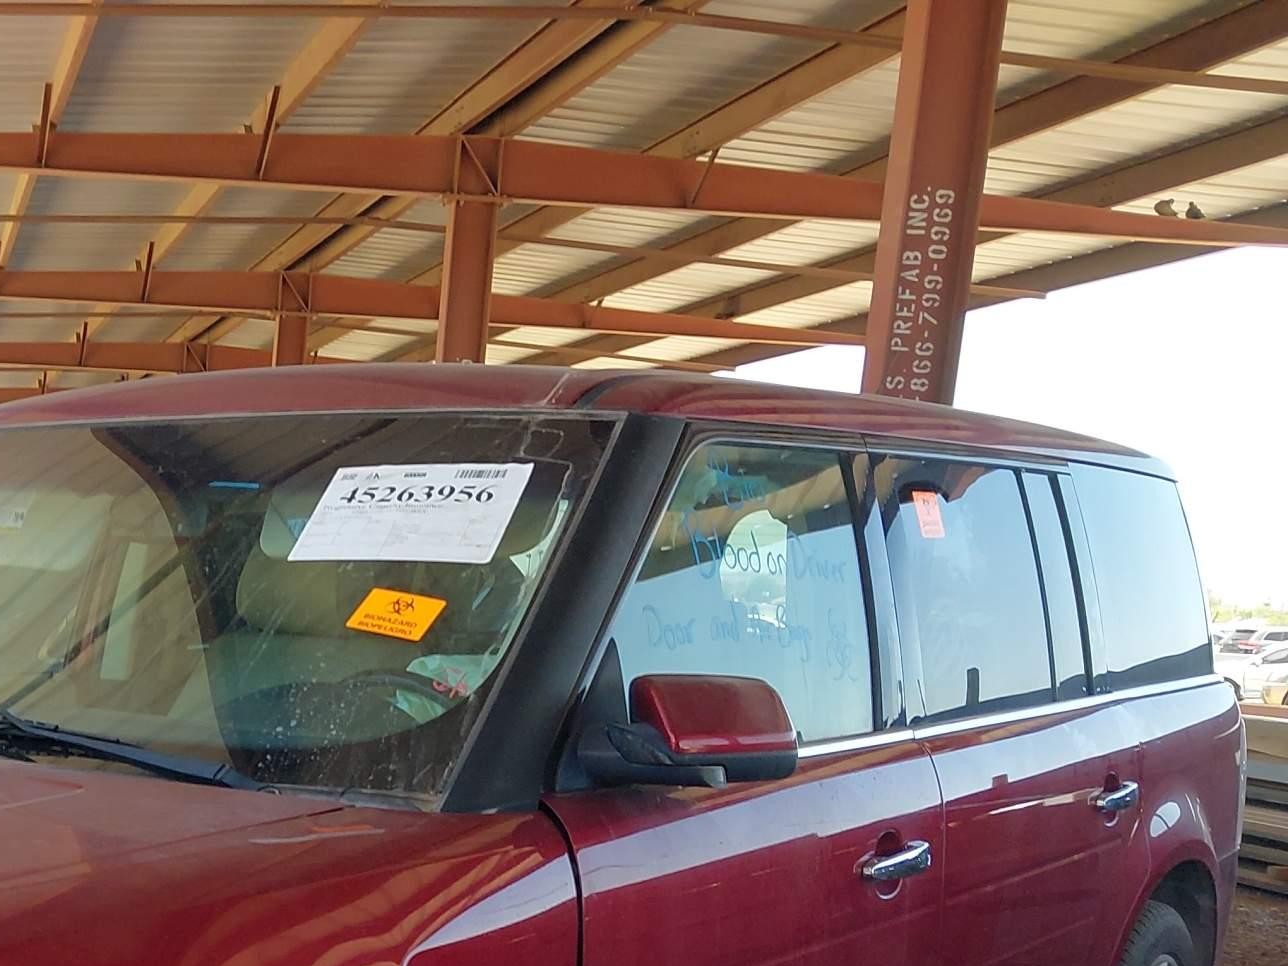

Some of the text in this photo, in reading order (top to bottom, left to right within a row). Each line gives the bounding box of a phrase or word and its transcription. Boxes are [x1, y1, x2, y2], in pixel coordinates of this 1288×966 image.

[890, 249, 922, 352] PREFAB
[906, 185, 933, 236] INC.
[909, 188, 956, 403] -866-799-0969
[339, 484, 498, 504] 45263956
